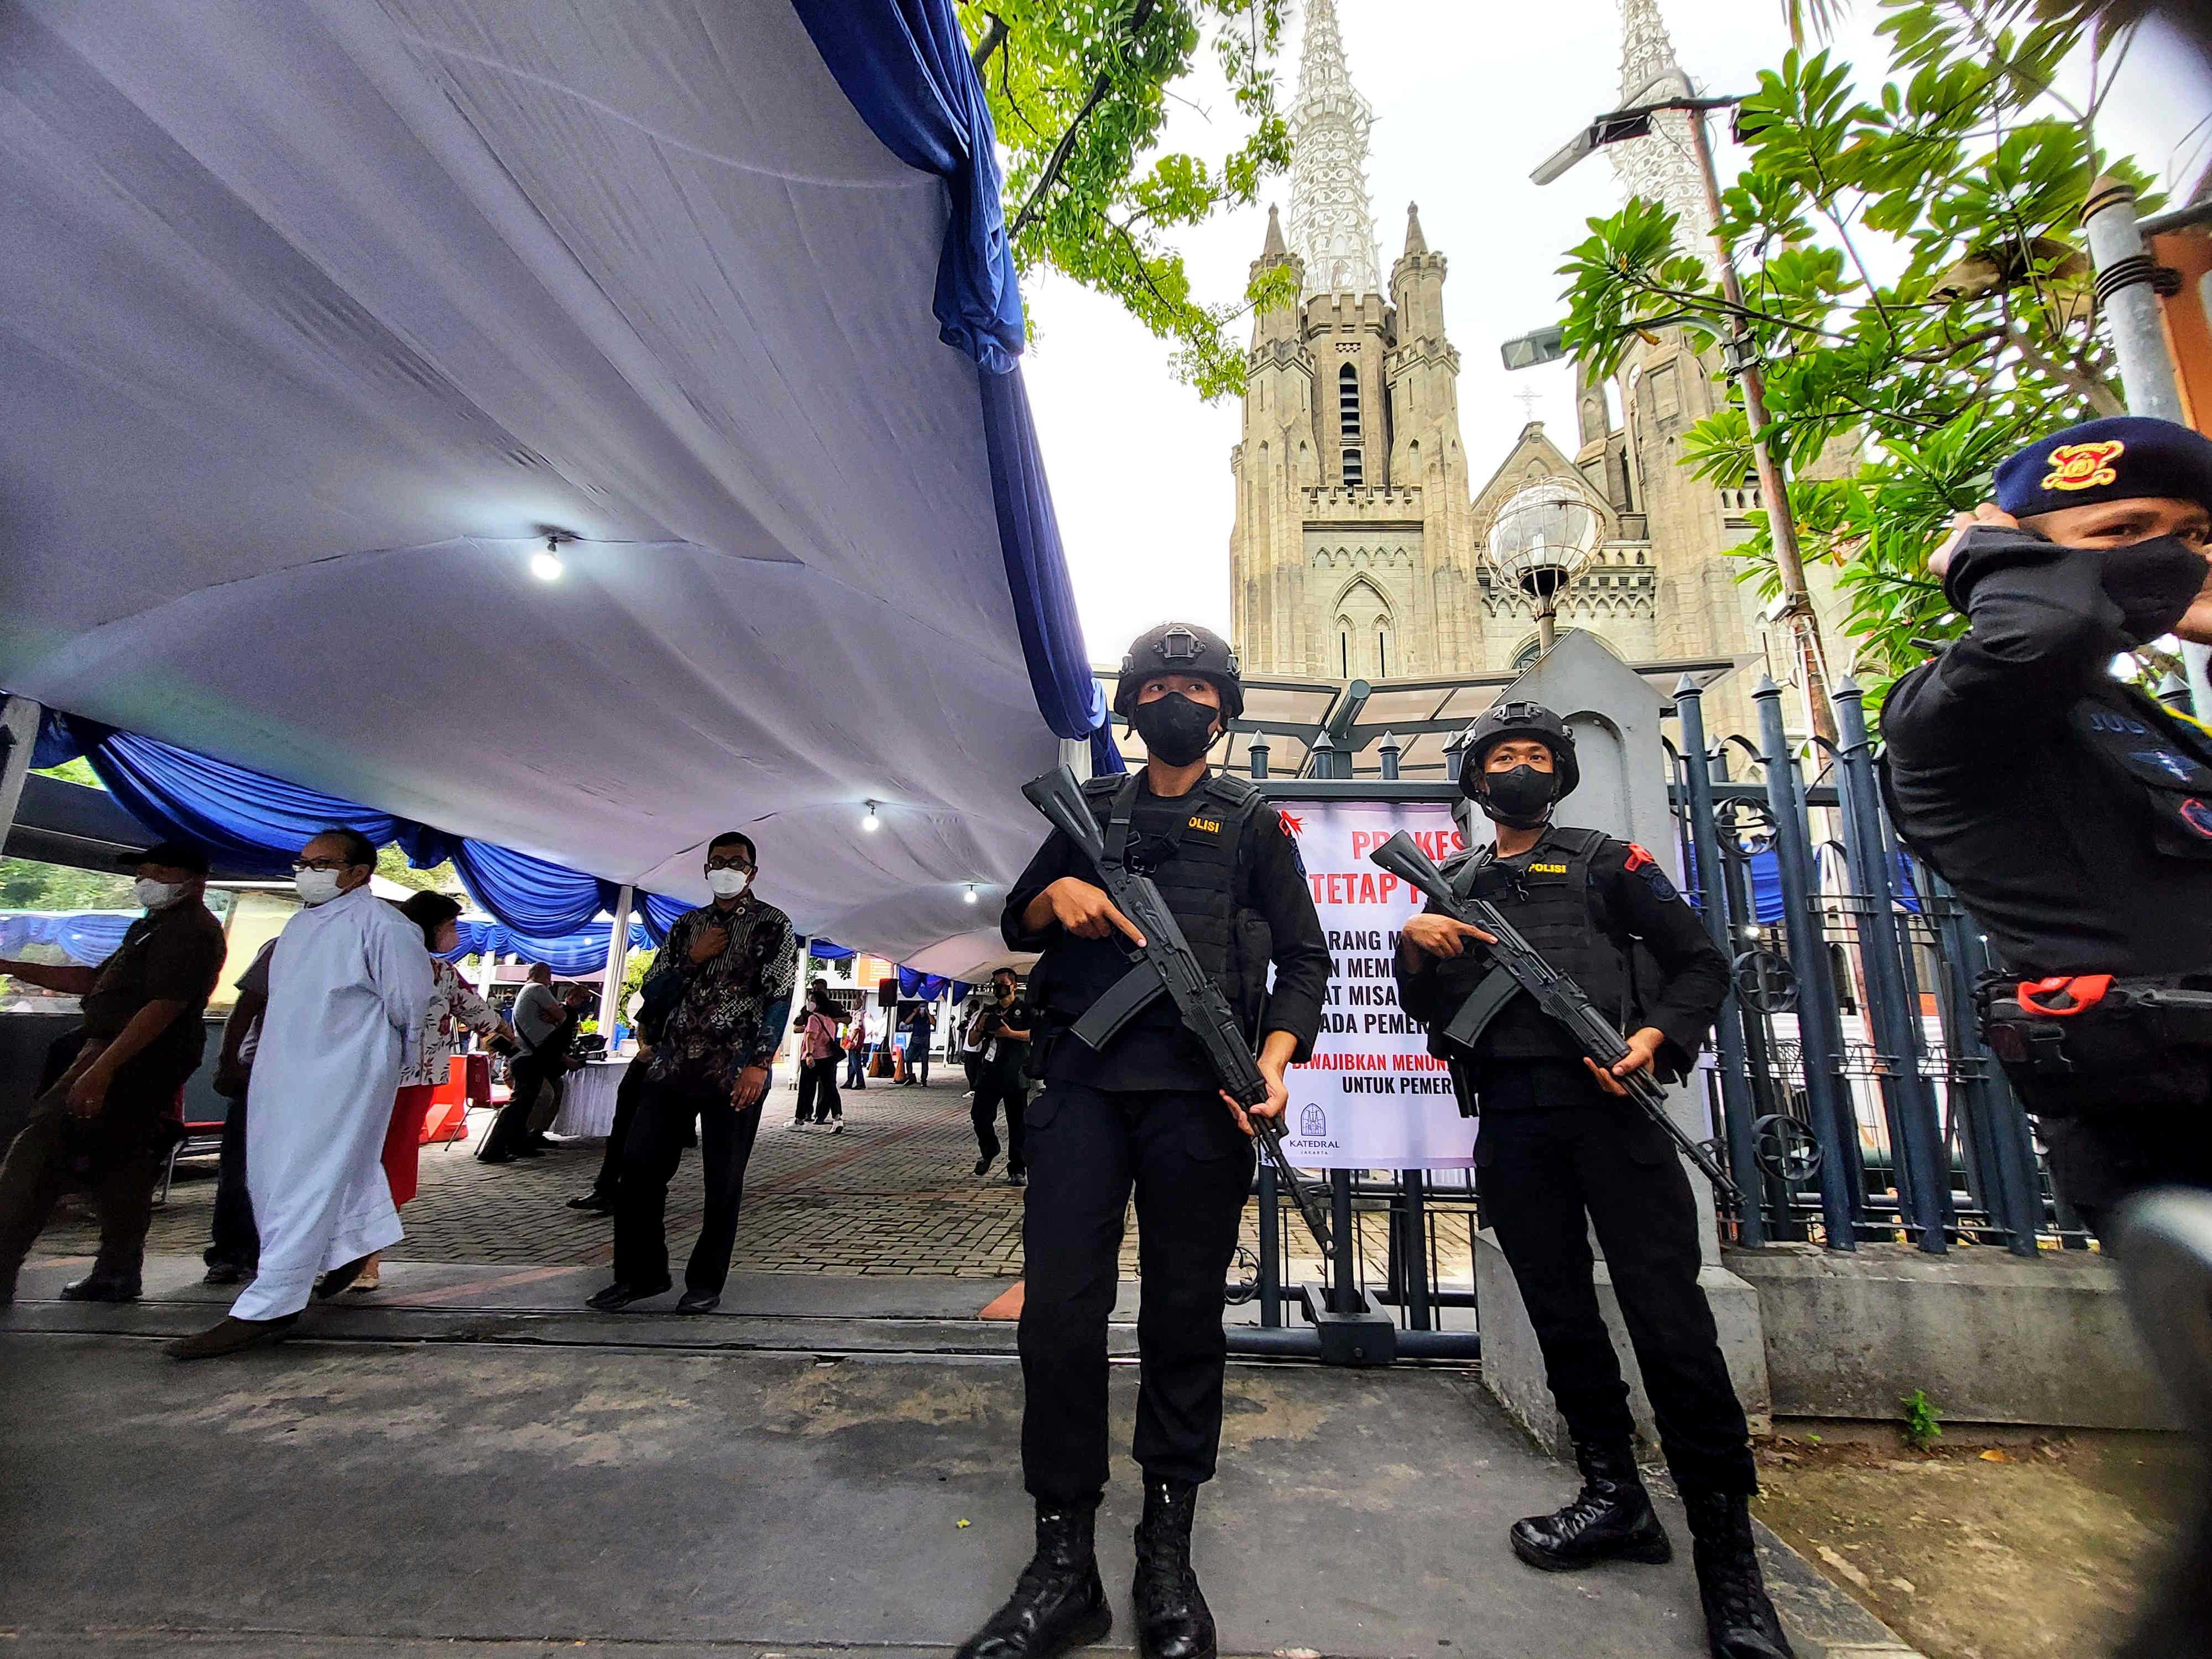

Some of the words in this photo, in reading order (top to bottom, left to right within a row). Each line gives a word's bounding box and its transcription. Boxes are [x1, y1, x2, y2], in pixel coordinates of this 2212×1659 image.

[1188, 817, 1219, 833] OLISI
[1352, 831, 1464, 860] PKES
[1310, 873, 1397, 904] TETAP
[1328, 931, 1381, 951] RANG
[1323, 985, 1342, 1005] AT
[1349, 985, 1397, 1006] MISA
[1319, 1013, 1358, 1033] ADA
[1364, 1014, 1430, 1034] PEMER
[1393, 1054, 1449, 1071] MENUN
[1342, 1076, 1395, 1093] UNTUK
[1400, 1077, 1453, 1094] PEMER
[1290, 1140, 1340, 1148] KATEDRAL
